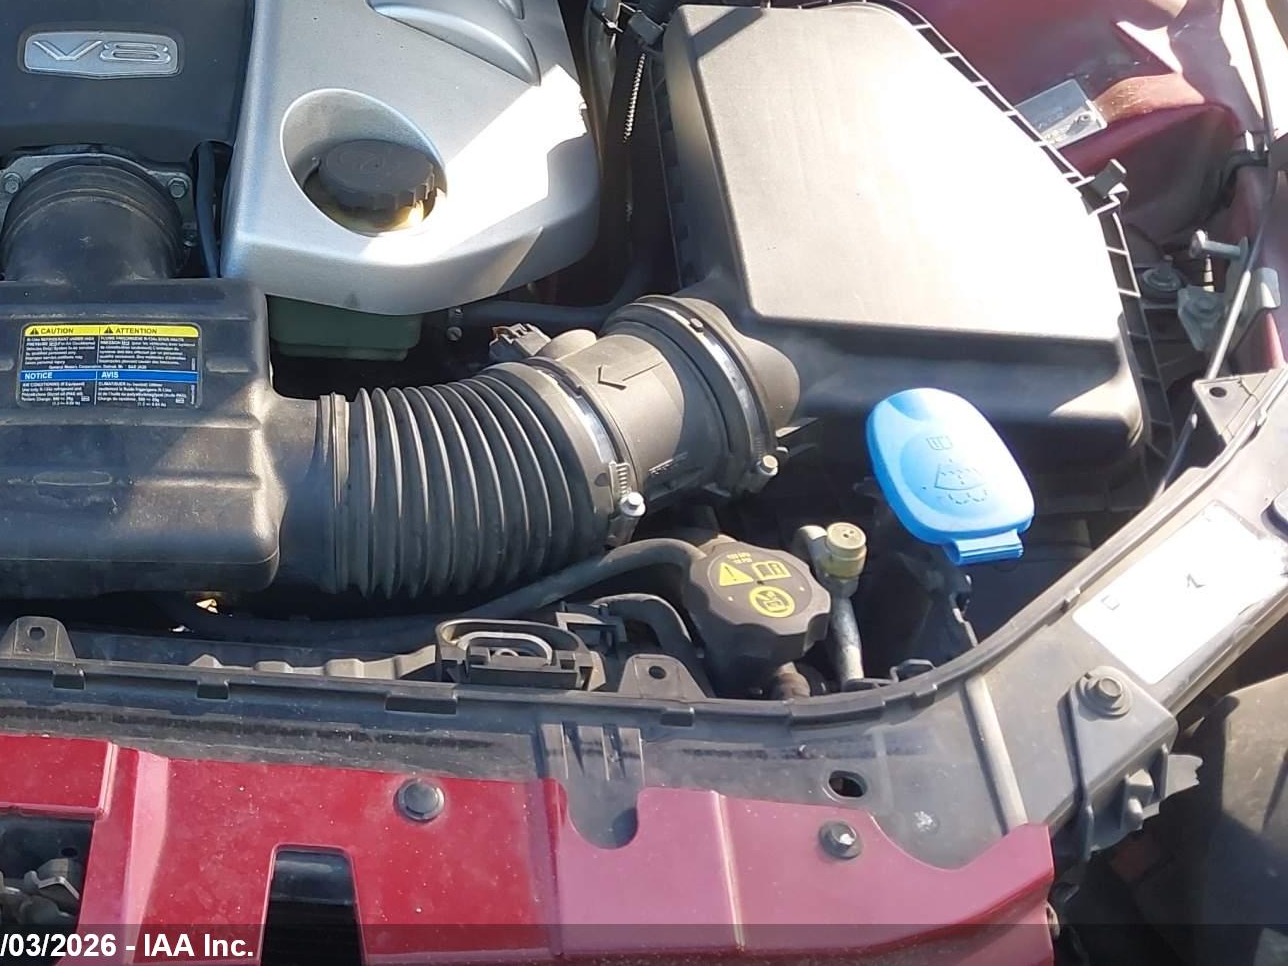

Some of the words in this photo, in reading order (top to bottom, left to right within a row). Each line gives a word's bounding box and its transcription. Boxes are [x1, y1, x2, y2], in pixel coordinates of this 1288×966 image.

[32, 40, 171, 64] V8
[24, 372, 53, 380] NOTICE
[101, 371, 119, 379] AVIS
